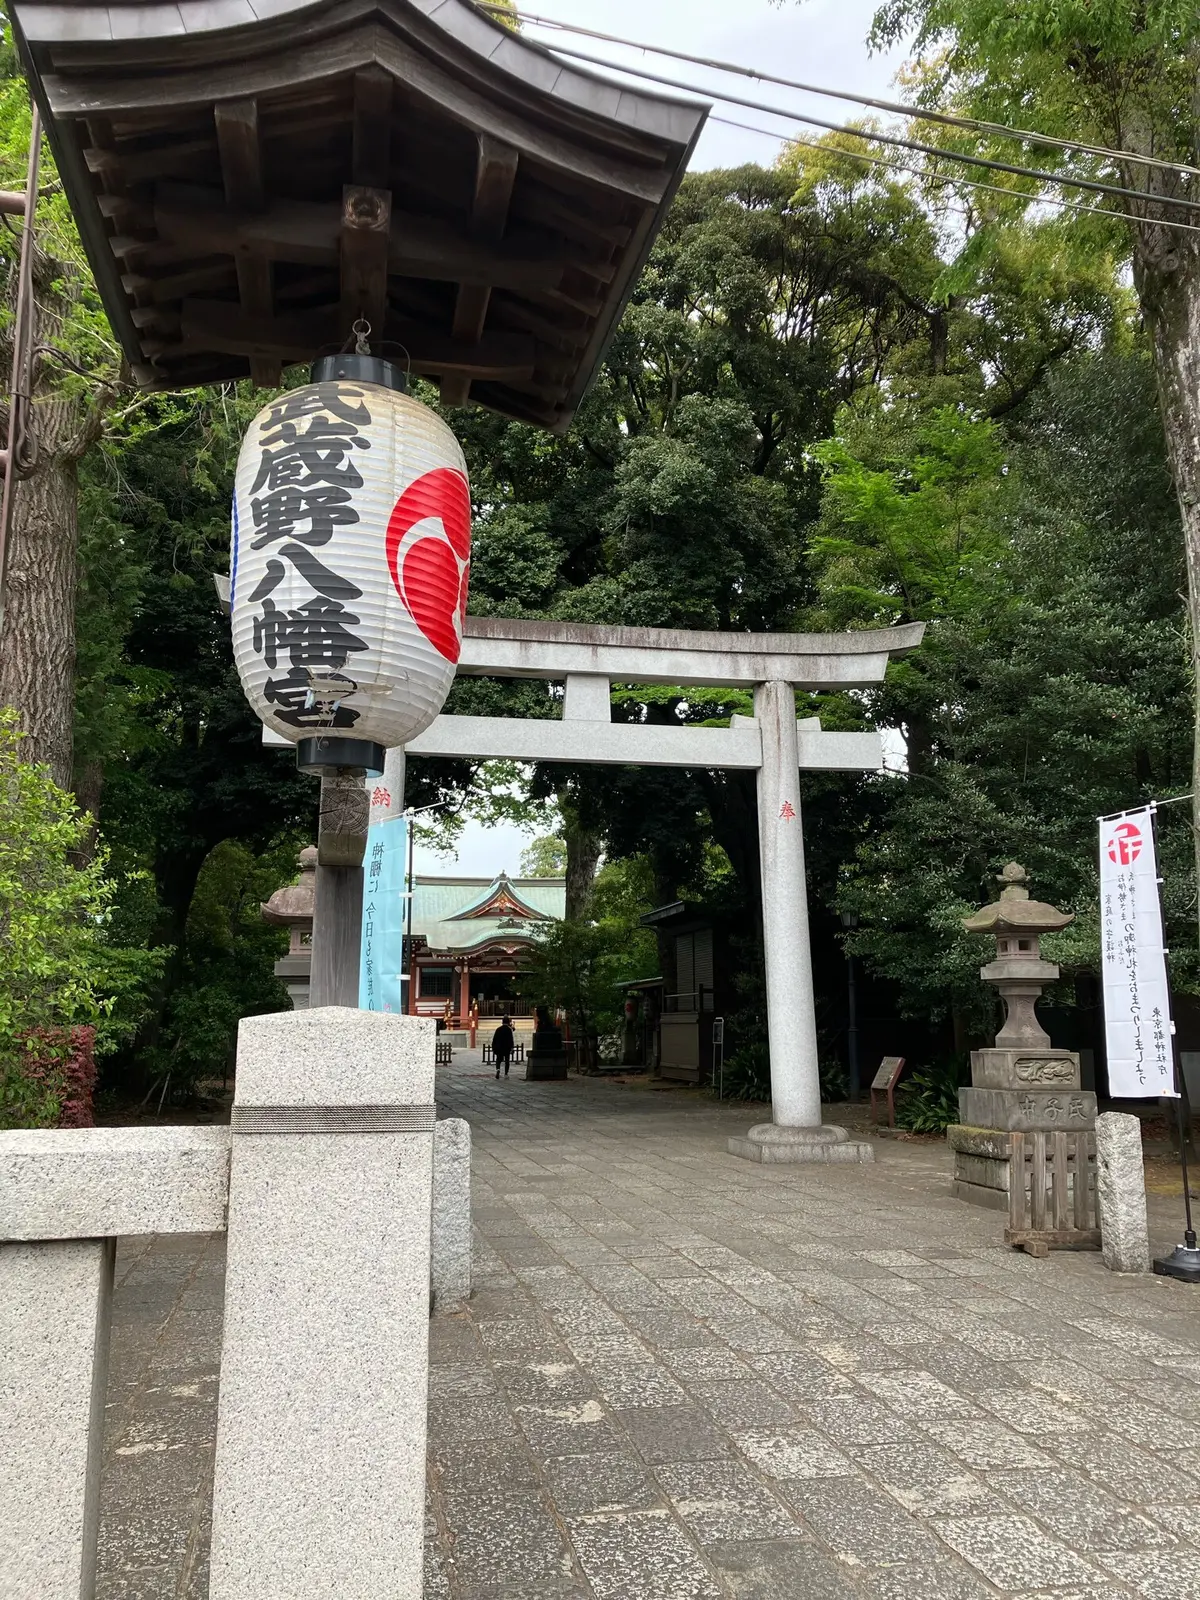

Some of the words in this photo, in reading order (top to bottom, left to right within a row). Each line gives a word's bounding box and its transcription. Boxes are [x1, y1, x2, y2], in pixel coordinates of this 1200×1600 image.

[248, 382, 373, 728] 武蔵野八幡宮
[371, 786, 391, 808] 納
[779, 800, 796, 824] 奉
